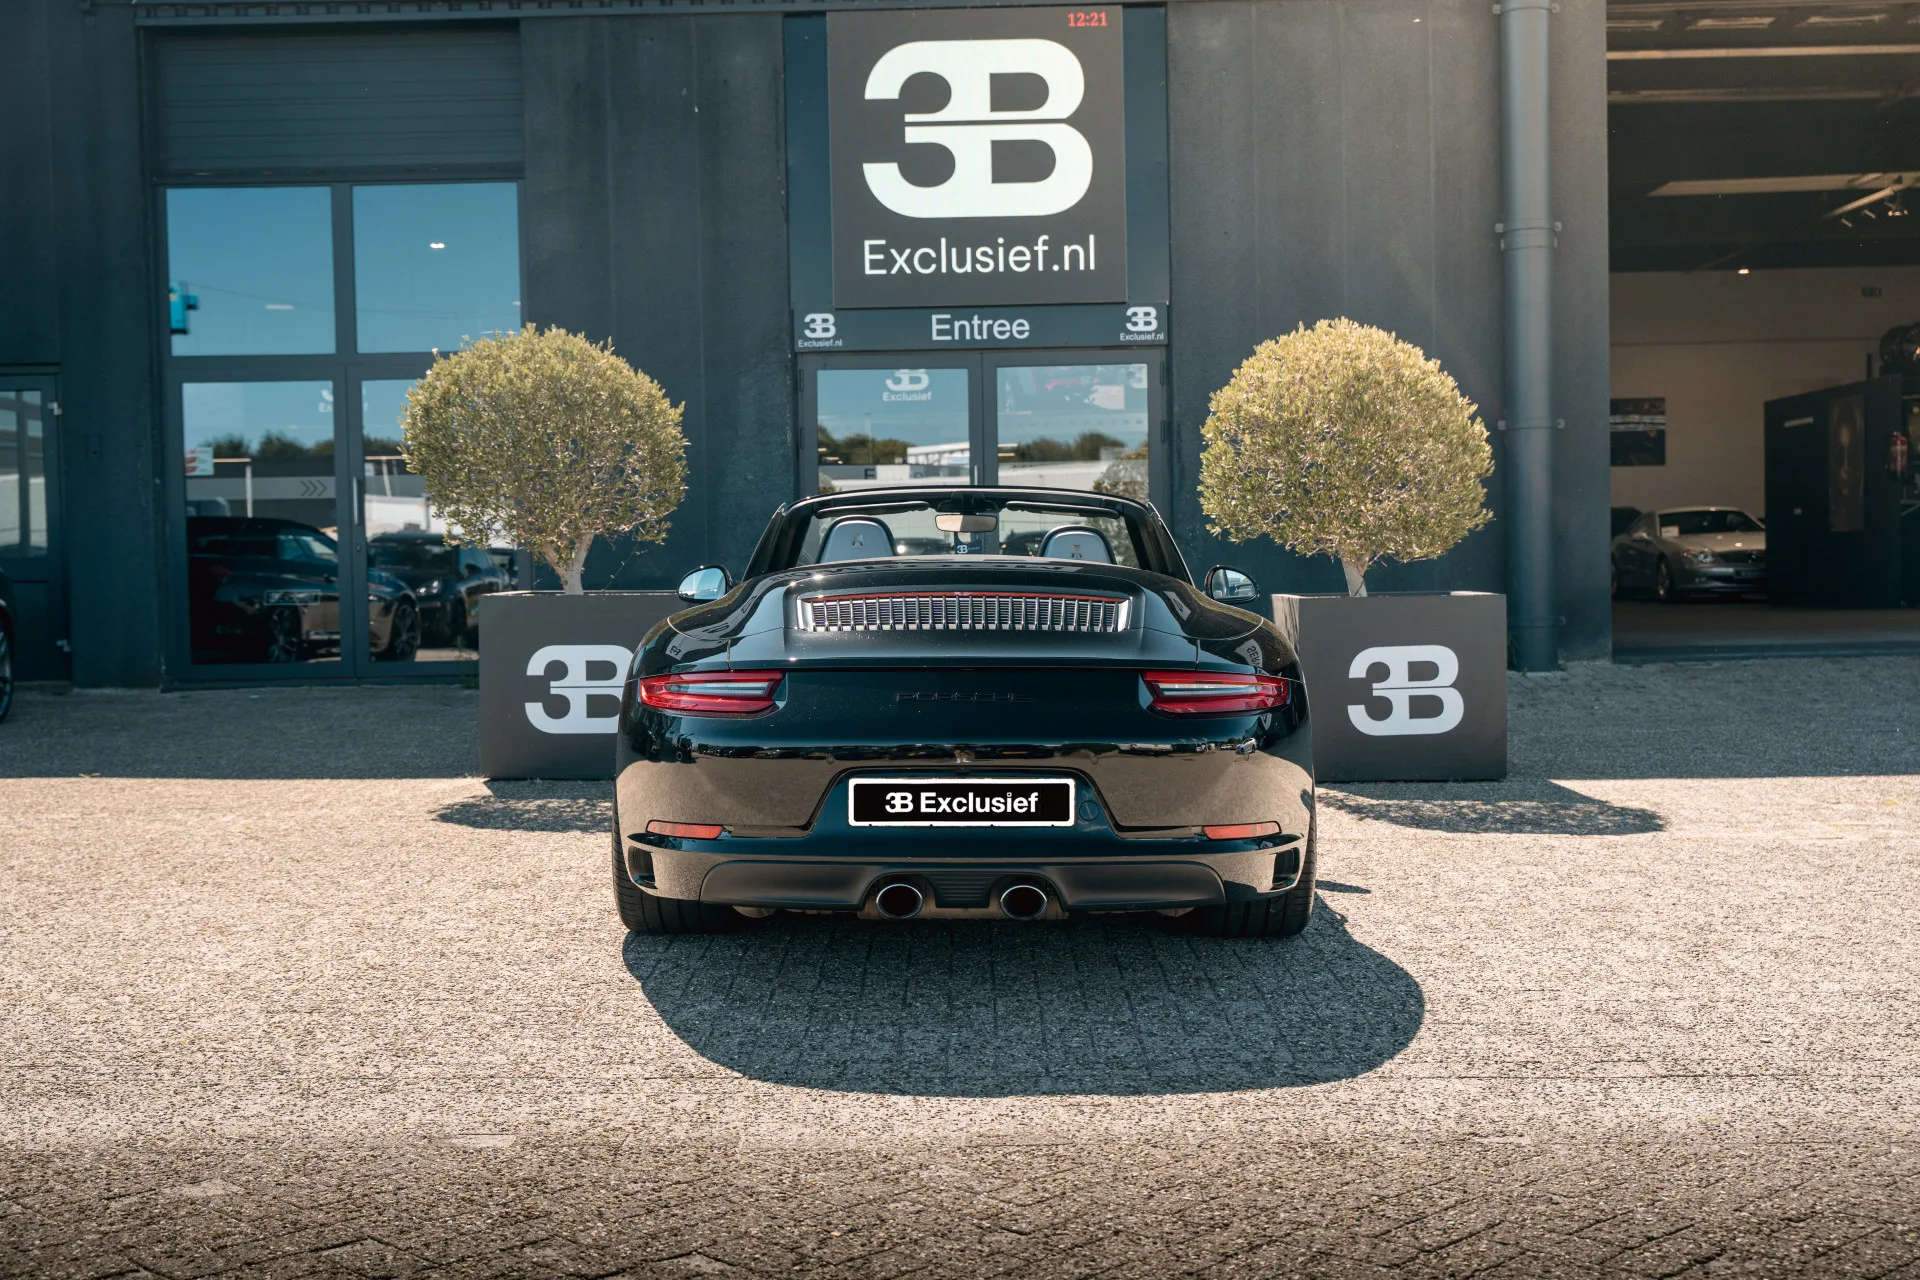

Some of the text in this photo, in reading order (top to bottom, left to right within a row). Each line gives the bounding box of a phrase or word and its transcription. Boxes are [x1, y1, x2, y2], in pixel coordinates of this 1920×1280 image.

[1067, 12, 1108, 28] 12:21
[862, 38, 1094, 219] 3B
[863, 234, 1096, 275] Exclusief.nl
[804, 313, 836, 339] 3B
[931, 314, 1030, 341] Entree
[1125, 306, 1158, 332] 3B
[798, 339, 843, 348] Exclusief.nl
[1119, 332, 1164, 341] Exclusief.nl
[882, 391, 932, 402] Exclusief
[525, 644, 634, 734] 3B
[1347, 644, 1465, 736] 3B
[885, 792, 1039, 813] 3B Exclusief
